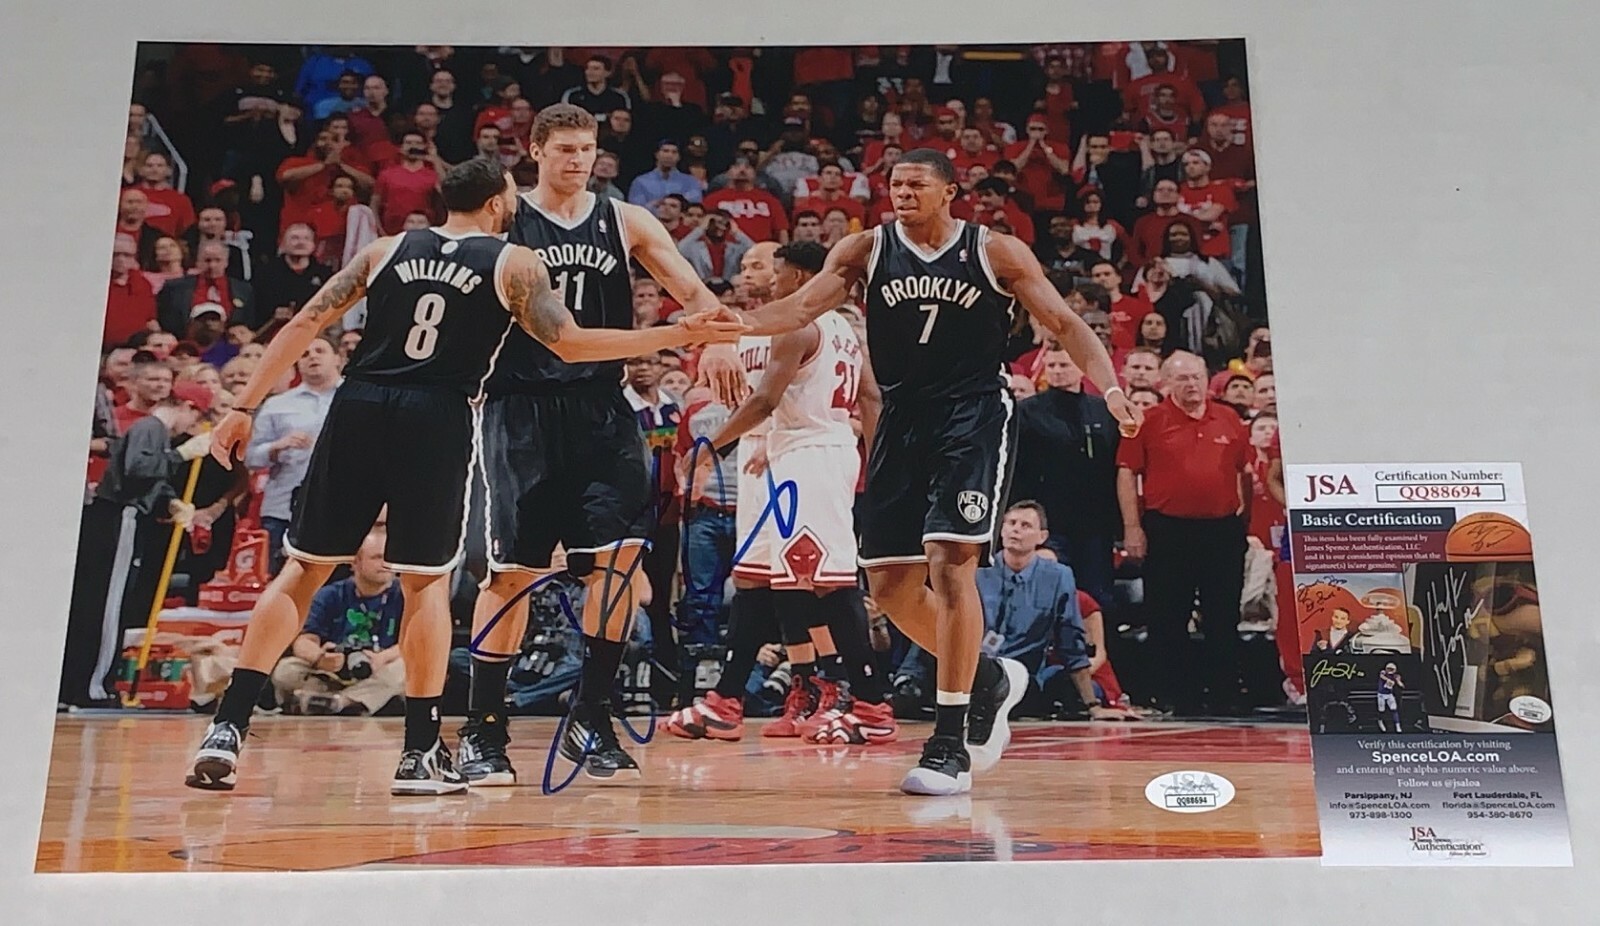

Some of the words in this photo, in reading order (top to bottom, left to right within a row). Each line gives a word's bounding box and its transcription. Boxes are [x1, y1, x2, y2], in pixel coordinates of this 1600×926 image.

[534, 243, 618, 276] ROOKLYN
[394, 258, 483, 294] WILLIAMS
[555, 271, 586, 310] 11
[881, 275, 982, 309] BROOKLYN
[404, 293, 446, 360] 8
[918, 304, 939, 344] 7
[1375, 471, 1447, 481] Certification
[1451, 470, 1503, 480] Number:
[1304, 474, 1358, 502] JSA
[1399, 486, 1482, 500] QQ88694
[1302, 513, 1342, 526] Basic
[1345, 512, 1442, 526] Certification
[1367, 534, 1383, 543] fully
[1419, 534, 1428, 542] by
[1304, 544, 1324, 552] James
[1325, 544, 1350, 553] Spence
[1405, 543, 1422, 551] LLC
[1385, 553, 1413, 561] opinion
[1306, 562, 1346, 571] signature(s)
[1358, 740, 1386, 751] Verify
[1387, 740, 1406, 749] this
[1407, 740, 1462, 749] certification
[1463, 740, 1474, 751] by
[1476, 740, 1511, 751] visiting
[1372, 751, 1500, 764] SpenceLOA.com
[1336, 765, 1354, 774] and
[1356, 765, 1395, 775] entering
[1396, 765, 1411, 774] the
[1481, 764, 1506, 773] value
[1508, 764, 1538, 774] above.
[1397, 778, 1429, 788] Follow
[1431, 780, 1442, 788] us
[1444, 778, 1481, 789] @jsaloa
[1344, 792, 1398, 800] Parsippany,
[1475, 792, 1529, 800] Lauderdale,
[1349, 811, 1413, 819] 973-898-1300
[1409, 826, 1437, 841] JSA
[1412, 842, 1481, 851] Authentication
